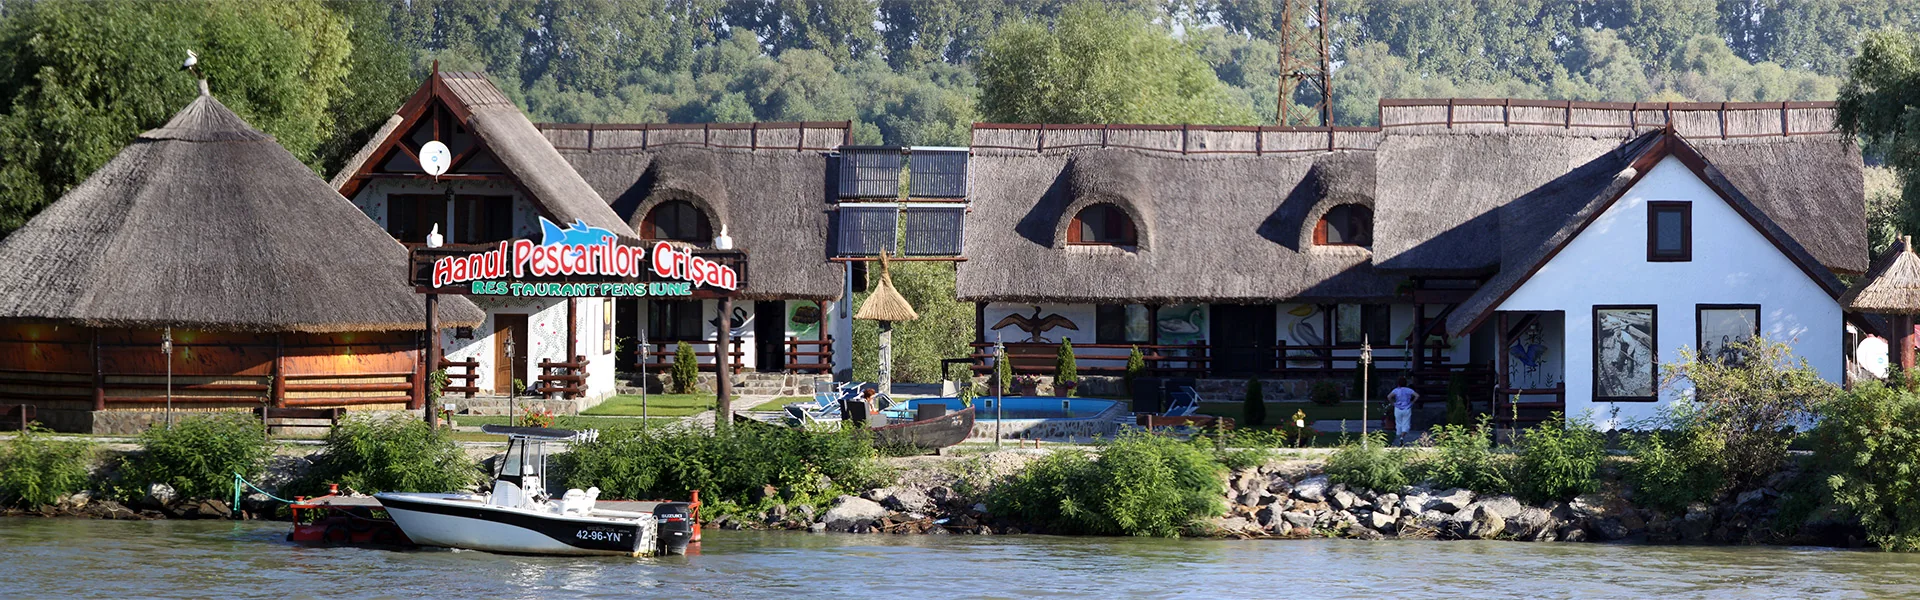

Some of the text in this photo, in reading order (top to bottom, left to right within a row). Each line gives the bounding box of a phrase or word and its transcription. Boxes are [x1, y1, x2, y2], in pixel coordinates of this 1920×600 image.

[433, 241, 508, 288] Hanul
[513, 240, 644, 278] Pescarilor
[576, 530, 620, 542] 42-96-YN
